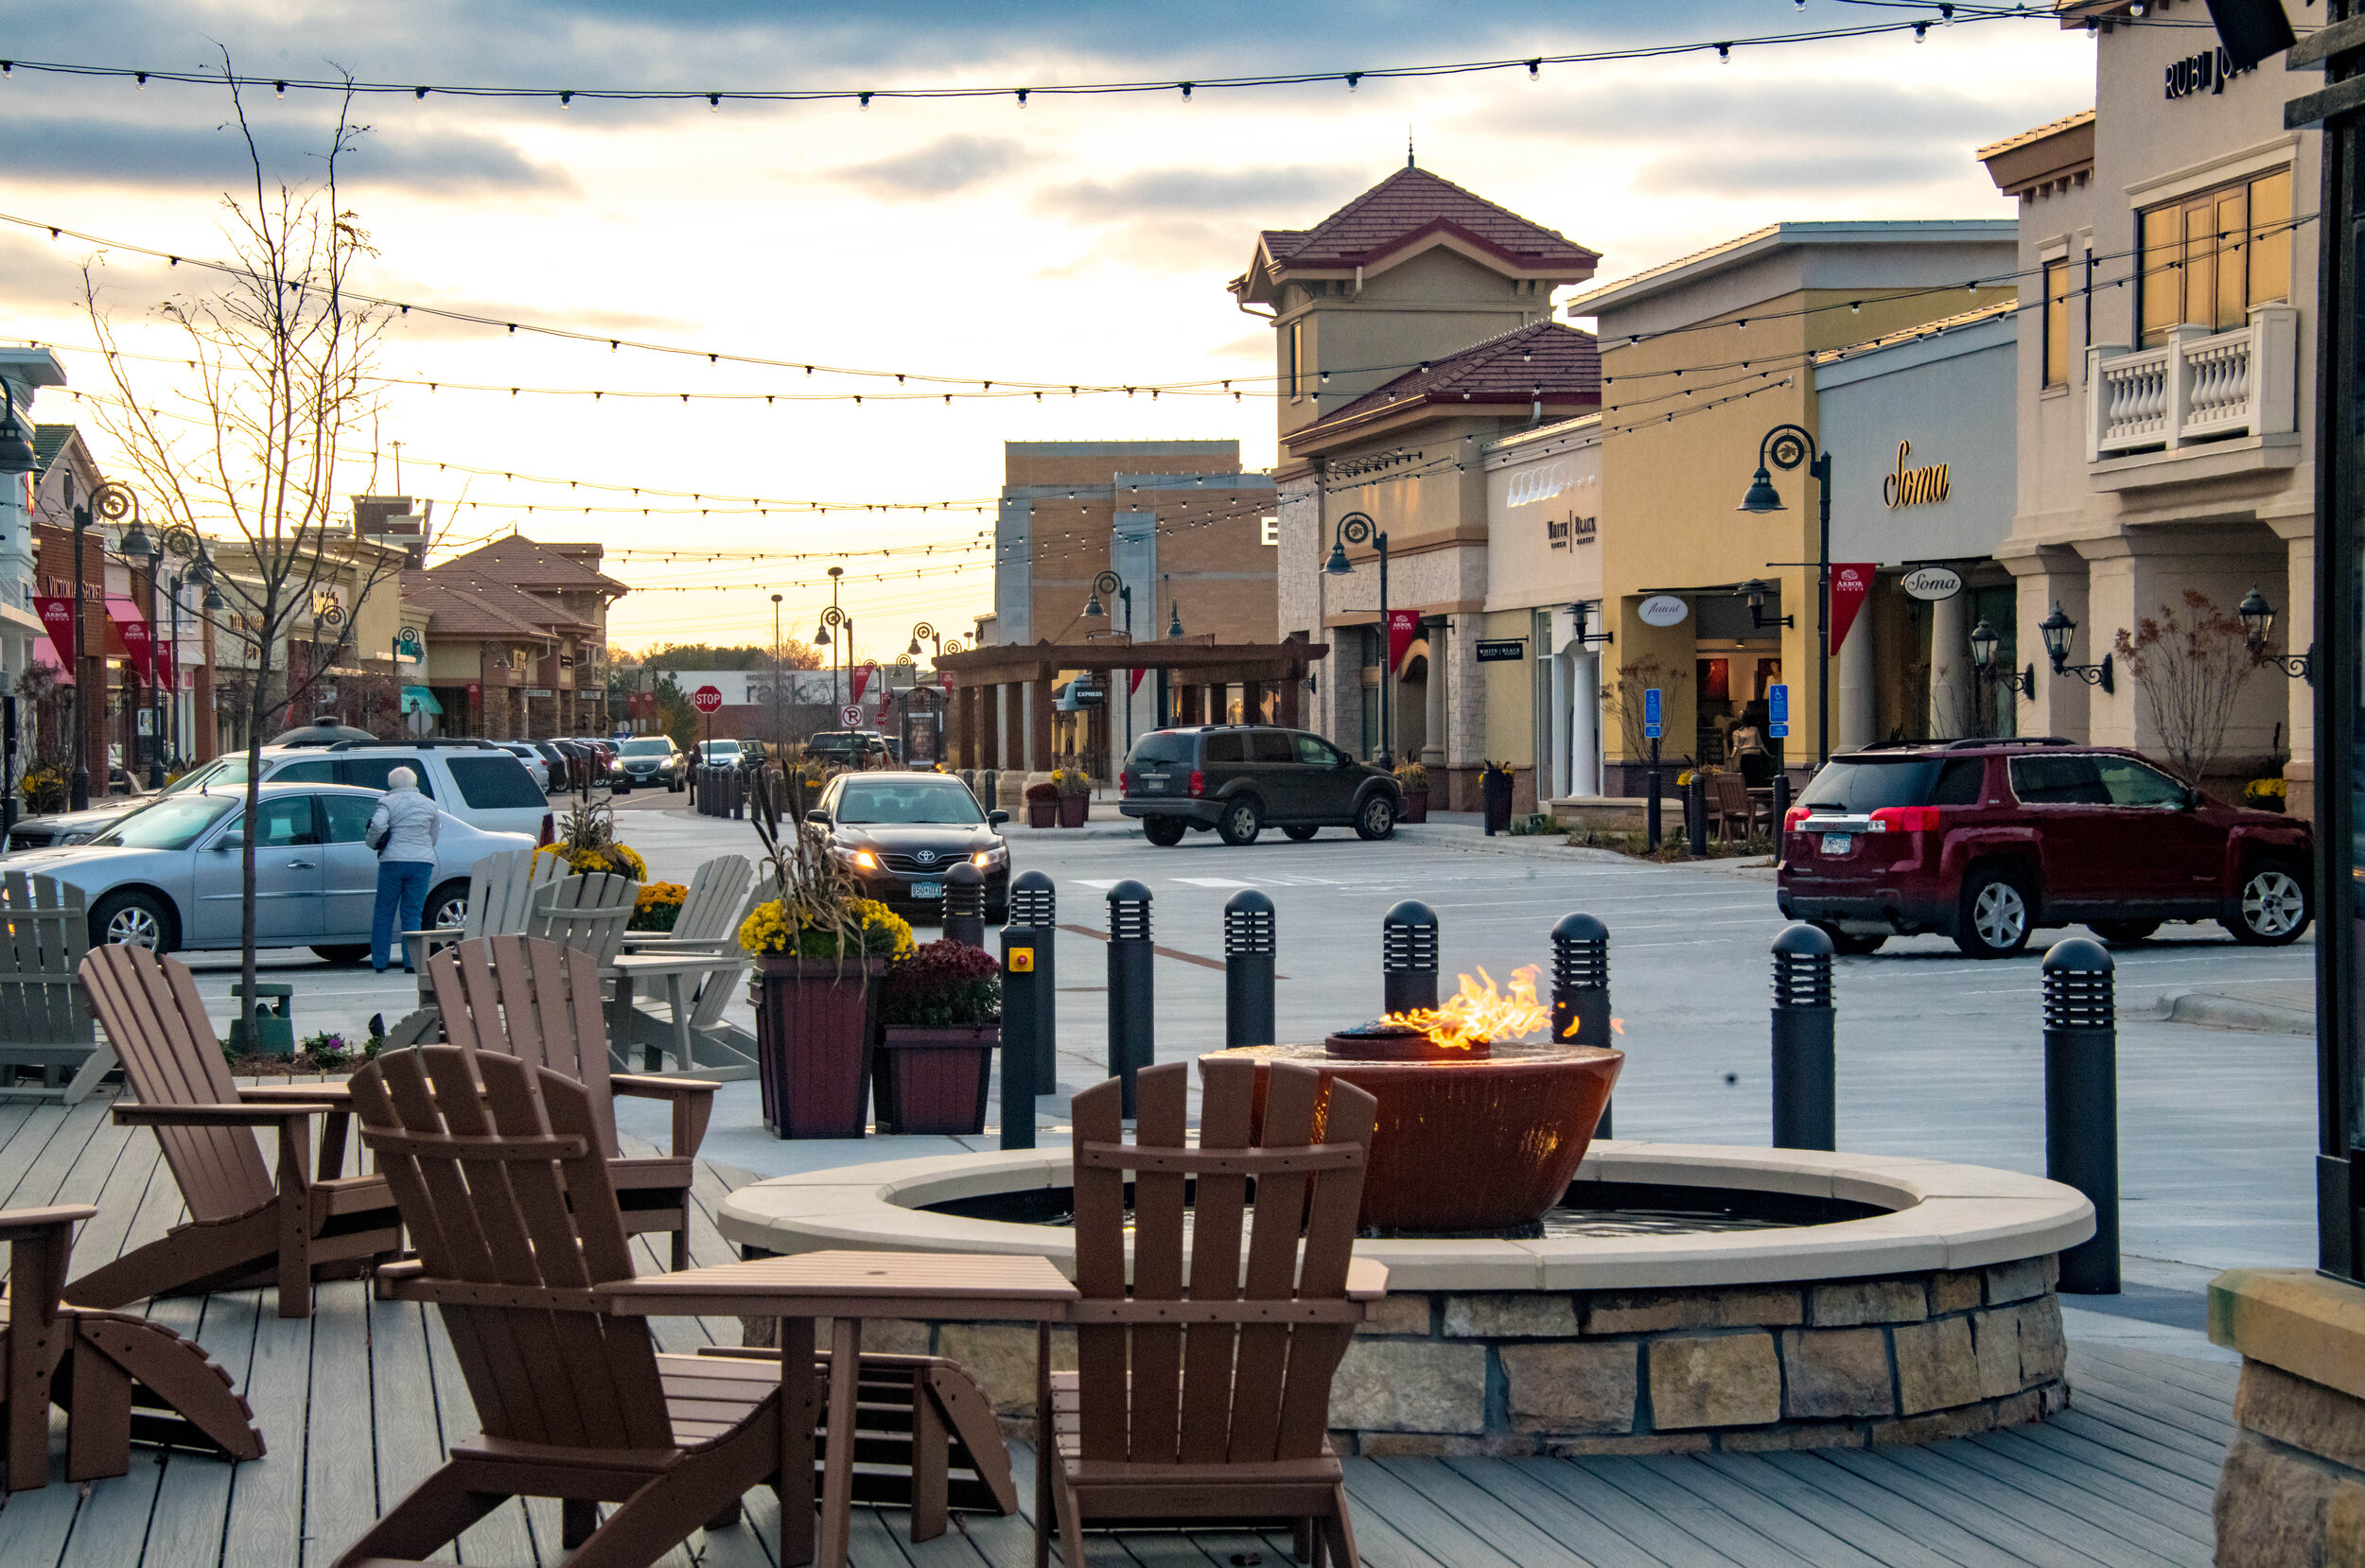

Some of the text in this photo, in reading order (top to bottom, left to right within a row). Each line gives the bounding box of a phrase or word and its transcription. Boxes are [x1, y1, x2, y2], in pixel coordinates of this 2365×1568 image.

[2164, 50, 2213, 99] RUBI
[1883, 440, 1951, 509] Soma
[1547, 516, 1596, 539] WHITE BLACK
[82, 580, 102, 599] SECRET
[1906, 573, 1957, 591] Soma
[696, 693, 721, 705] STOP
